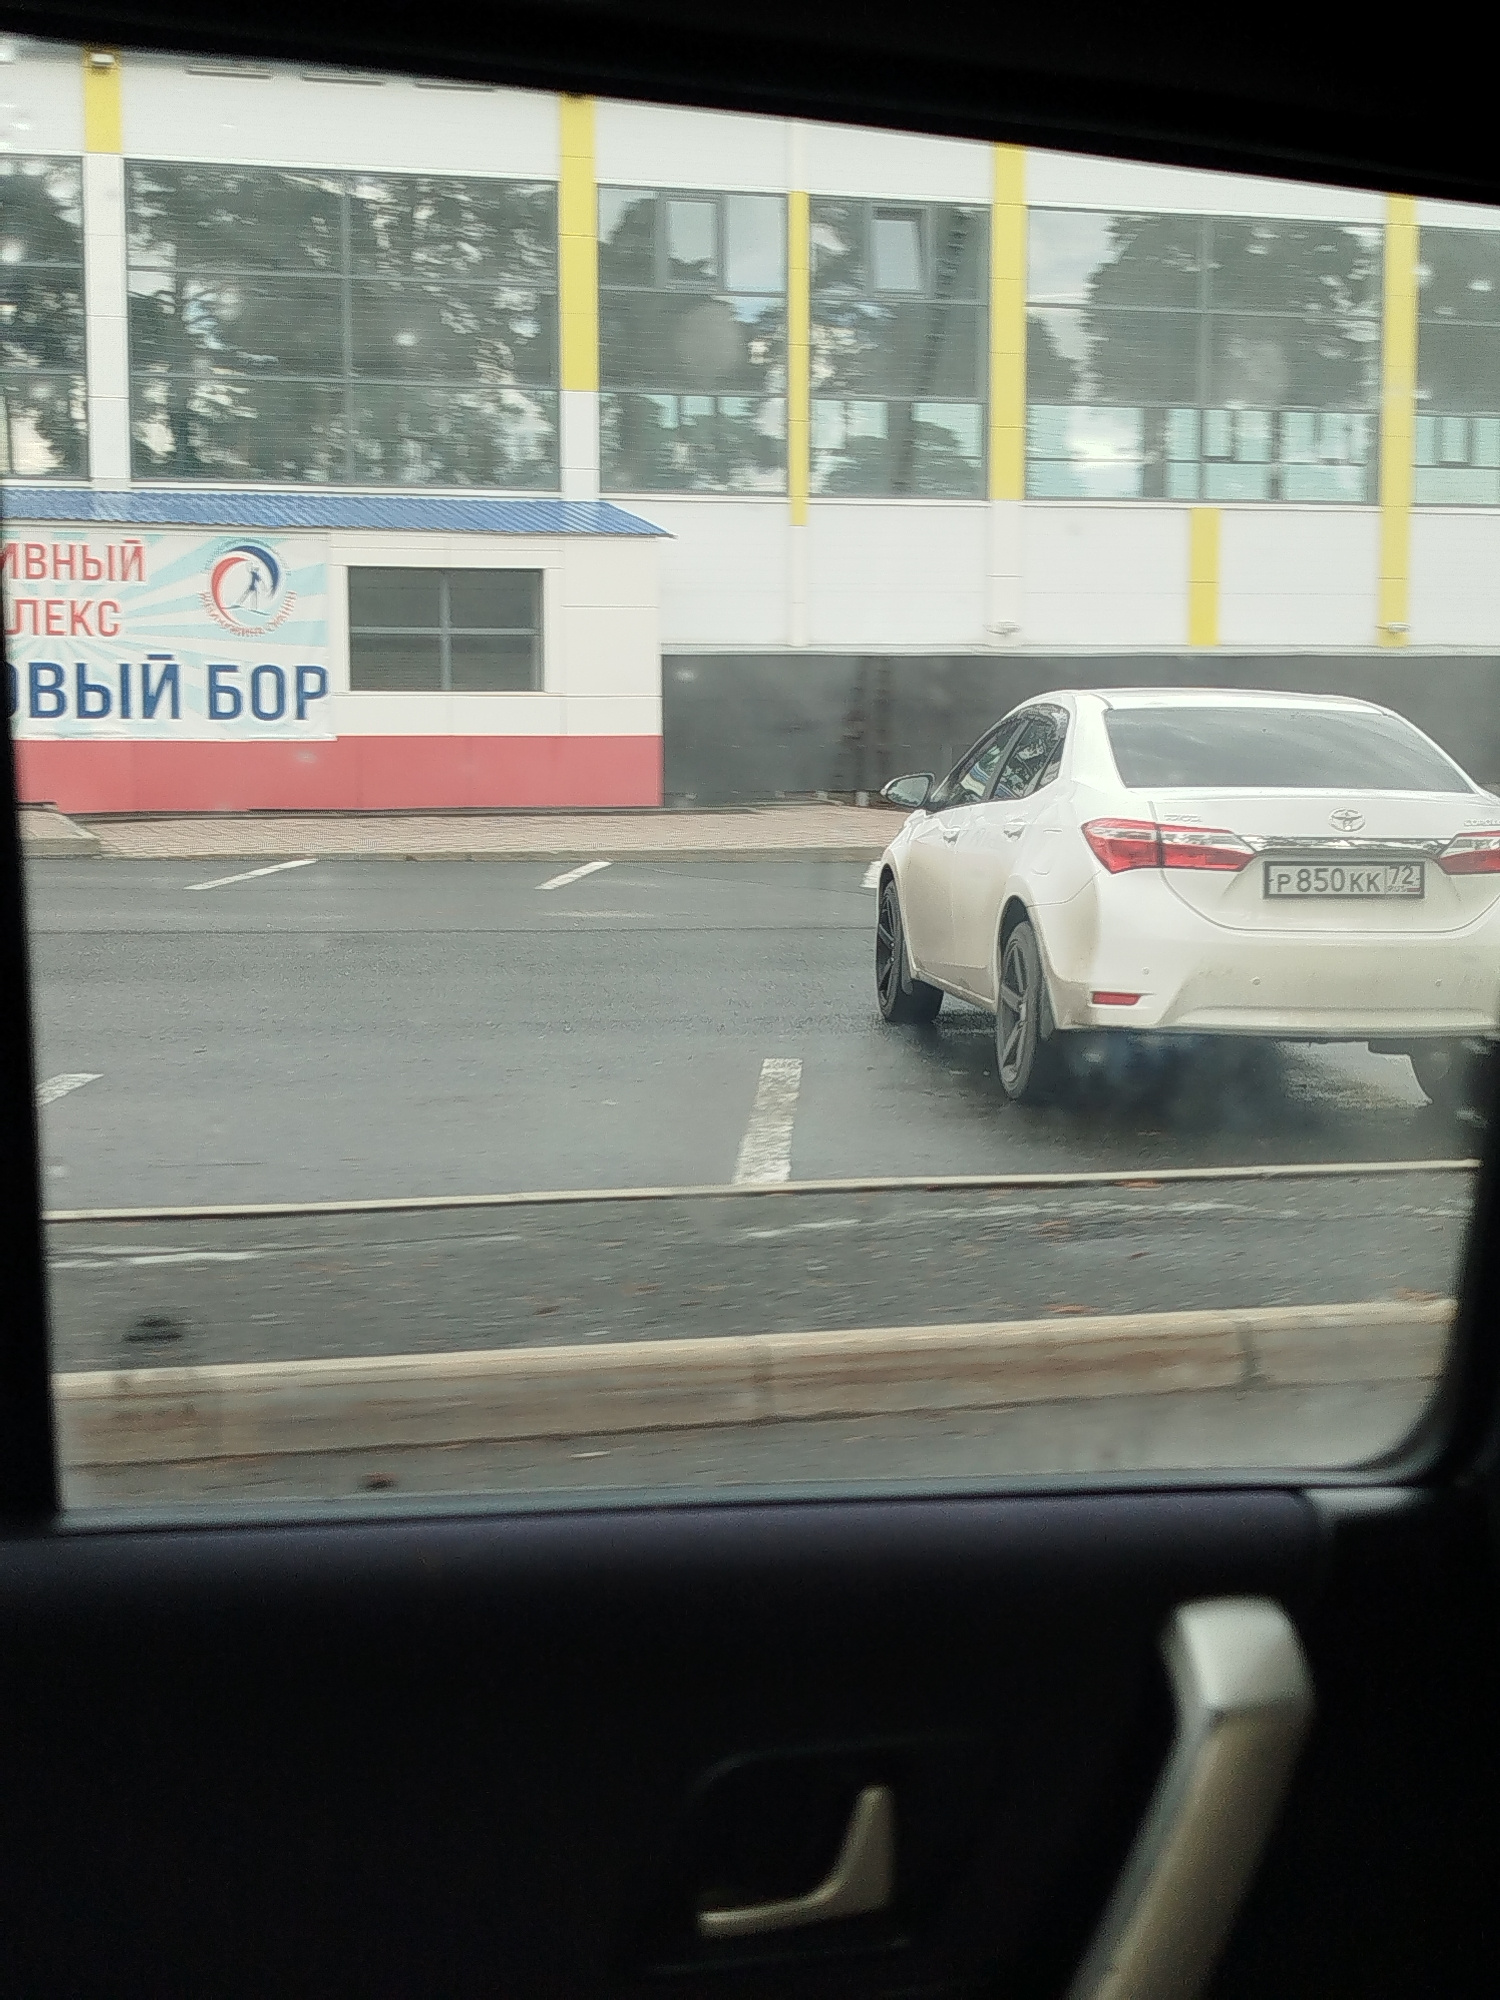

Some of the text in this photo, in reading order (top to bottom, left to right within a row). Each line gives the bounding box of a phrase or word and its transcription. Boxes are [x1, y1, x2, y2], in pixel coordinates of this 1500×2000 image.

[5, 599, 120, 637] ЛЕКС
[208, 664, 328, 721] БОР
[1389, 865, 1415, 885] 72
